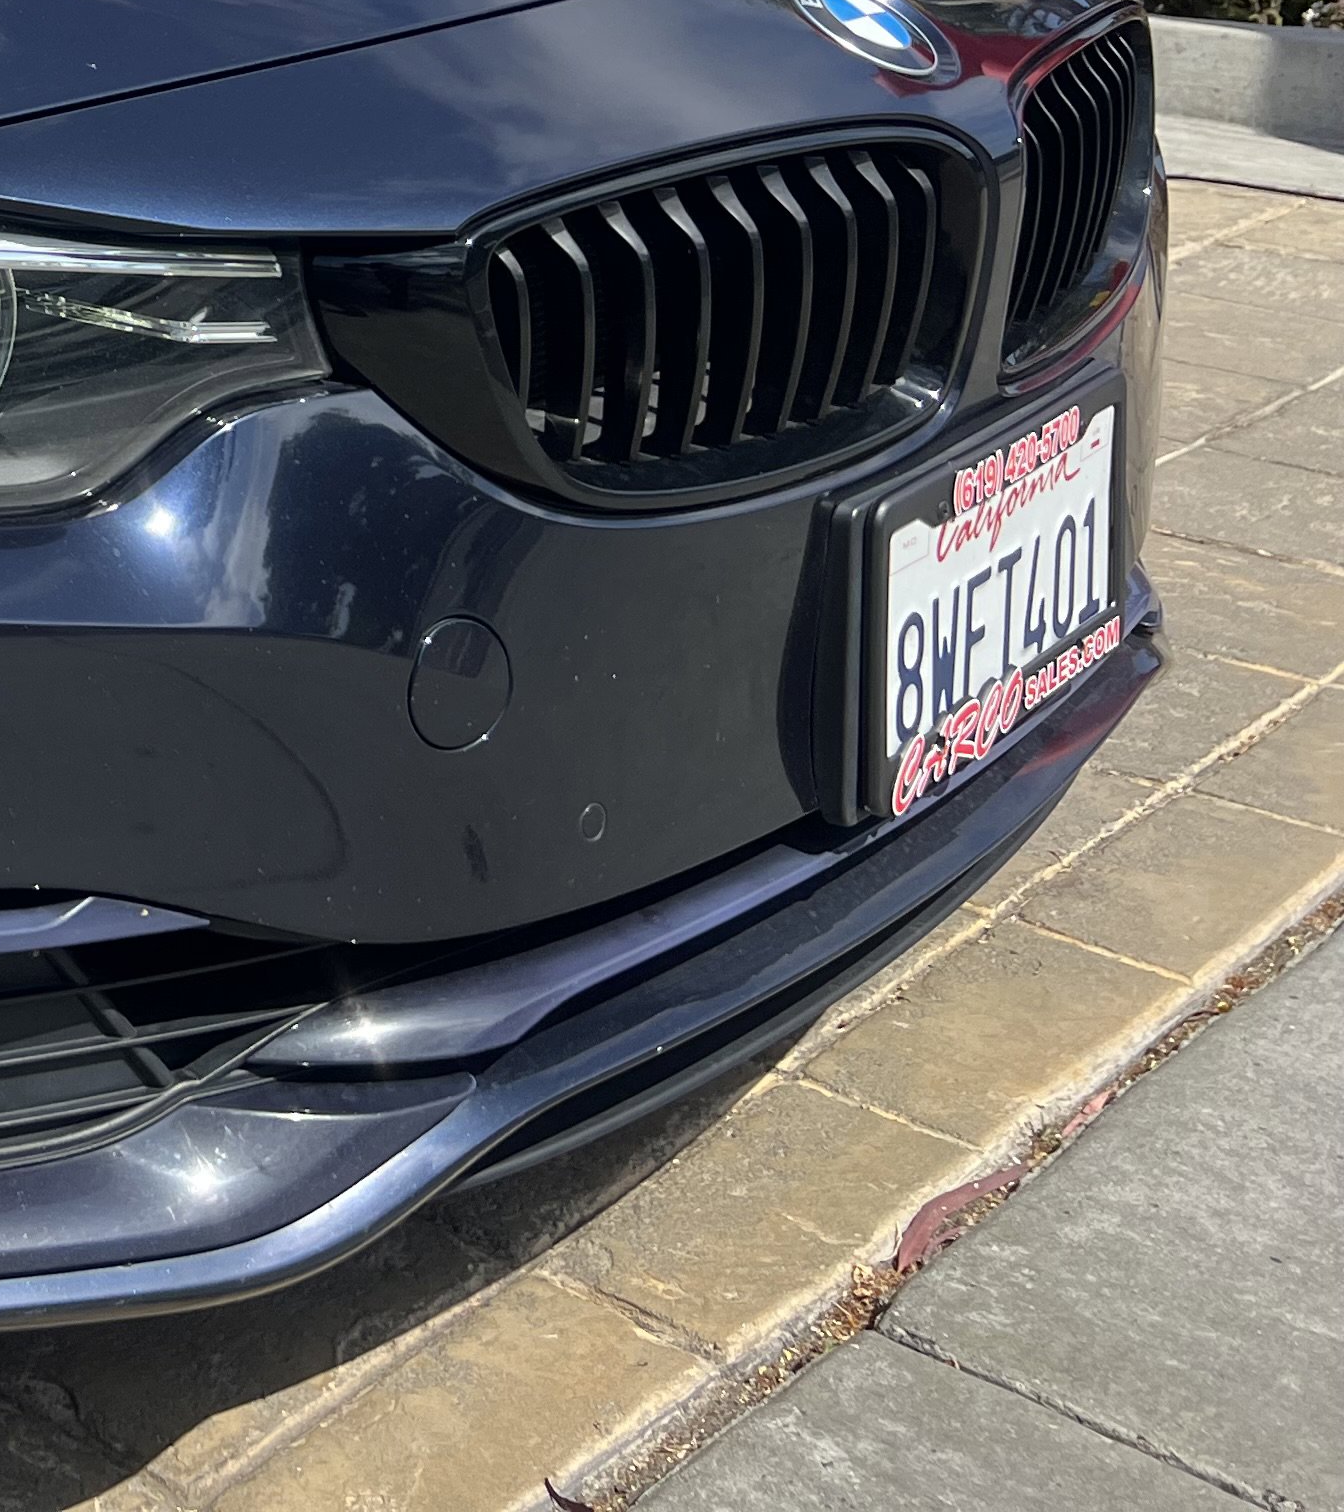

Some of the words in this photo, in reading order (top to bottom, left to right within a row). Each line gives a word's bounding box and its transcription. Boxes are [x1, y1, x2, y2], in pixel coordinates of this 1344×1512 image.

[953, 449, 1004, 516] (619)
[1004, 405, 1080, 484] 420-5700
[892, 666, 1023, 816] CARCO
[1023, 616, 1120, 710] SALES.COM
[896, 497, 1101, 745] 8WFT401
